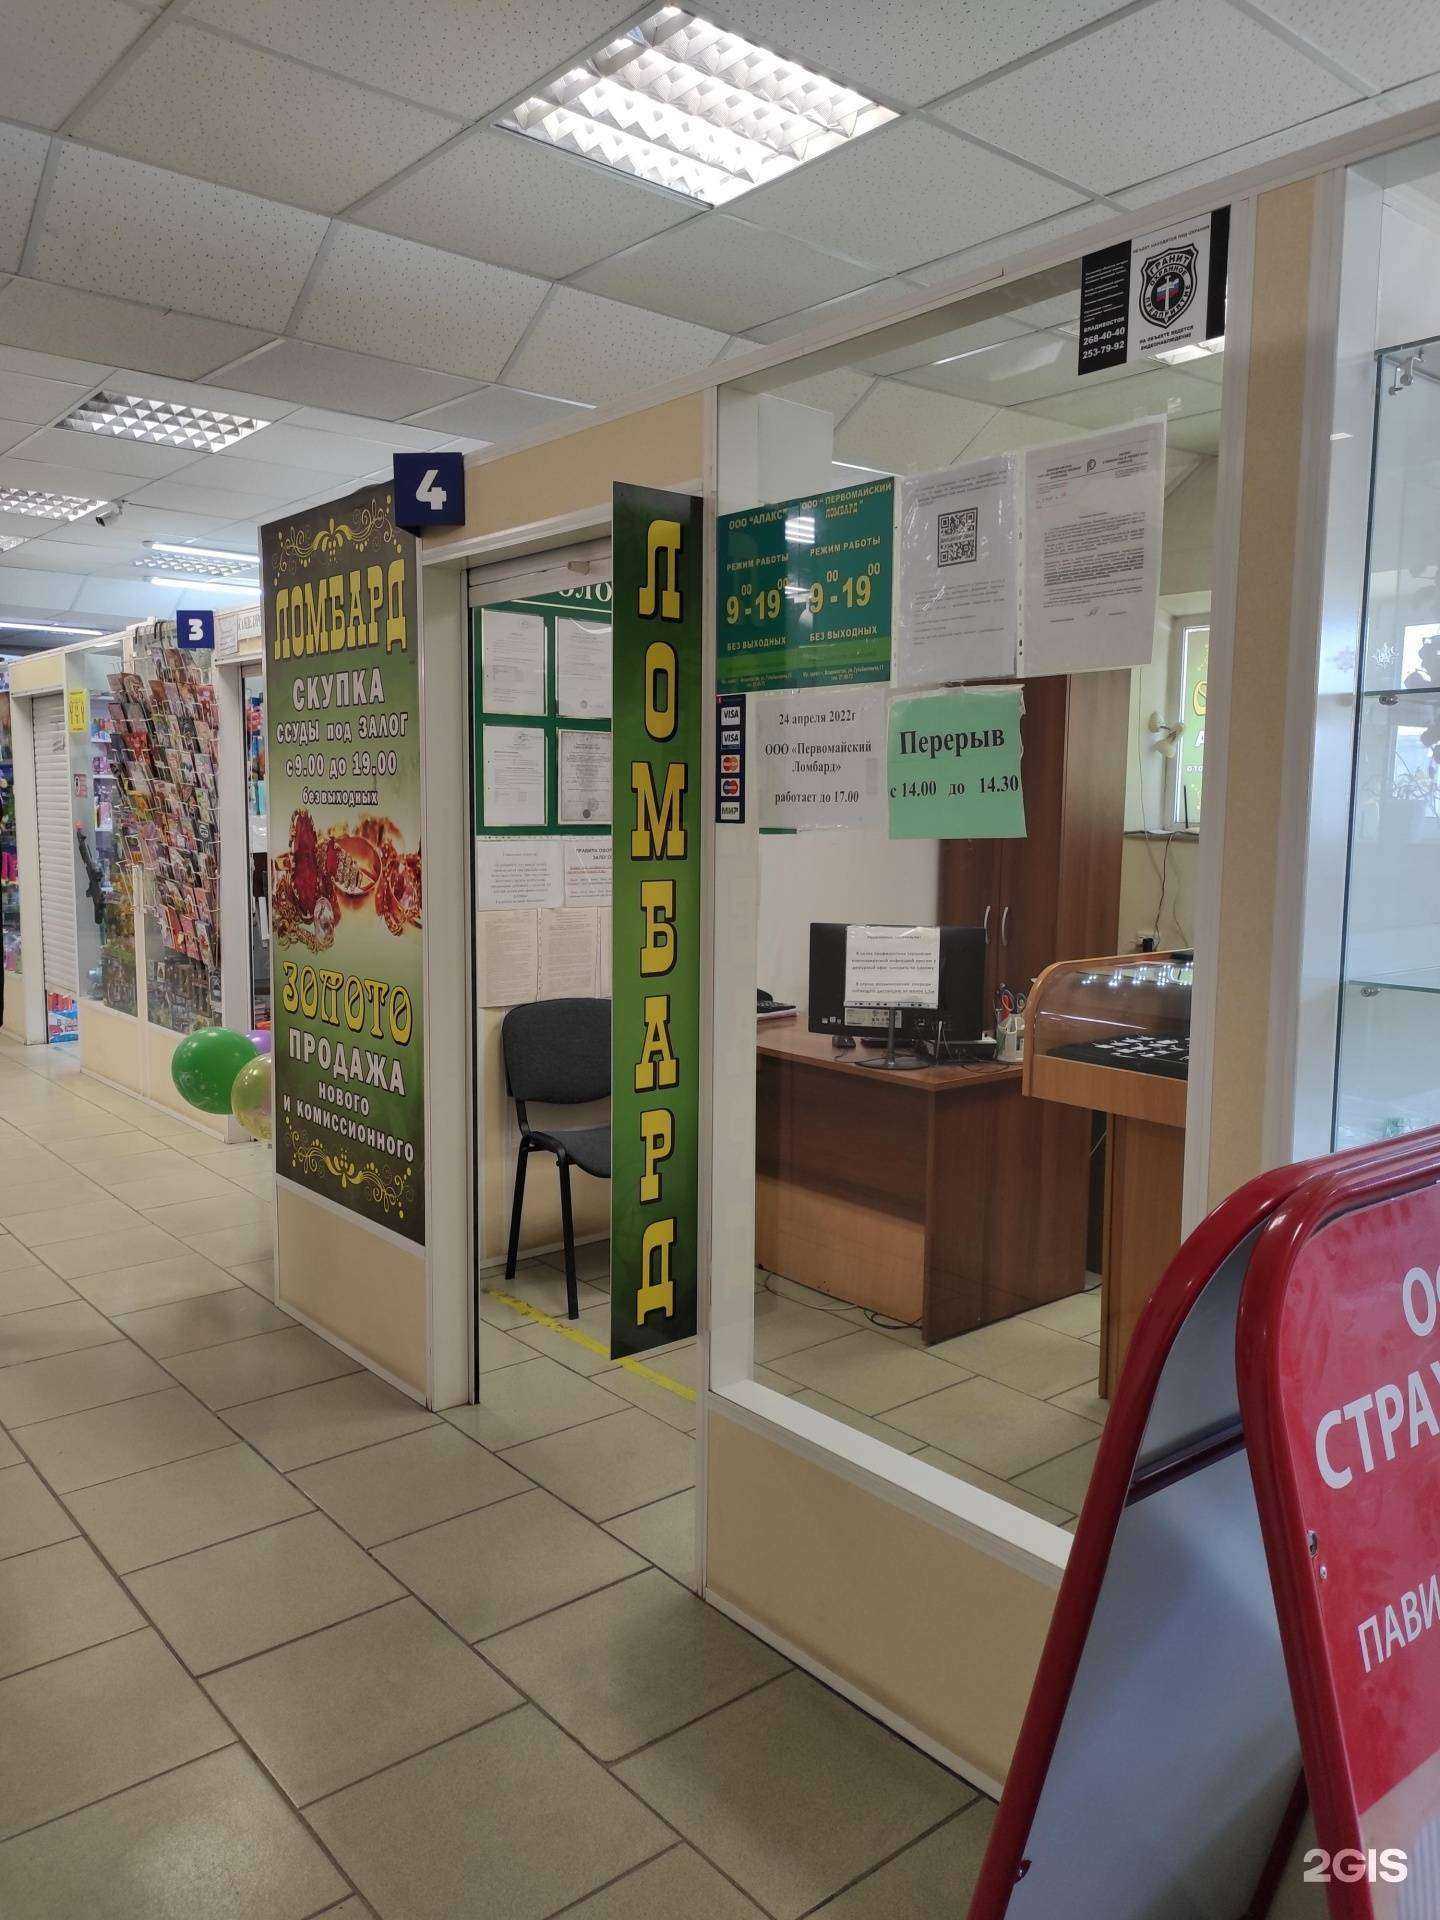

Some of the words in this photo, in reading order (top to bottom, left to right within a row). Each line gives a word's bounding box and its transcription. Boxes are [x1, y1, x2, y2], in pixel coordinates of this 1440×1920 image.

[1150, 253, 1191, 276] ГРАНИТ
[1149, 265, 1188, 287] ОХРАННОЕ
[1082, 326, 1126, 346] 268-40-40
[1082, 340, 1125, 360] 253-79-92
[415, 469, 447, 511] 4
[801, 499, 818, 512] ООО
[728, 518, 747, 530] ООО
[810, 543, 841, 557] РЕЖИМ
[844, 535, 881, 551] РАБОТЫ
[726, 559, 754, 571] РЕЖИМ
[756, 552, 789, 567] РАБОТЫ
[274, 558, 409, 661] ЛОМБАРД
[188, 618, 204, 641] 3
[809, 630, 825, 642] БЕЗ
[827, 625, 878, 641] ВЫХОДНЫХ
[727, 640, 741, 651] БЕЗ
[741, 636, 787, 651] ВЫХОДНЫХ
[292, 667, 386, 712] СКУПКА
[722, 708, 740, 721] VISA
[778, 713, 790, 726] 24
[792, 711, 827, 727] апреля
[829, 710, 857, 723] 2022г
[276, 719, 320, 746] ССУДЫ
[358, 712, 409, 739] ЗАЛОГ
[722, 731, 740, 744] VISA
[765, 744, 789, 757] ООО
[791, 740, 873, 757] «Первомайский
[899, 728, 1006, 760] Перерыв
[329, 757, 347, 780] до
[352, 750, 397, 776] 19.00
[791, 761, 842, 776] Ломбард»
[889, 785, 897, 799] с
[901, 780, 937, 799] 14.00
[947, 781, 966, 797] до
[978, 774, 1020, 795] 14.30
[774, 790, 817, 806] работает
[819, 793, 832, 804] до
[834, 790, 860, 804] 17.00
[721, 805, 740, 815] МИР
[630, 518, 688, 1328] ЛОМБАРД
[282, 960, 413, 1046] ЗОЛОТО
[288, 1026, 407, 1097] ПРОДАЖА
[318, 1081, 370, 1117] НОВОГО
[283, 1093, 291, 1113] И
[297, 1099, 415, 1163] КОМИССИОННОГО
[1402, 1264, 1440, 1337] О
